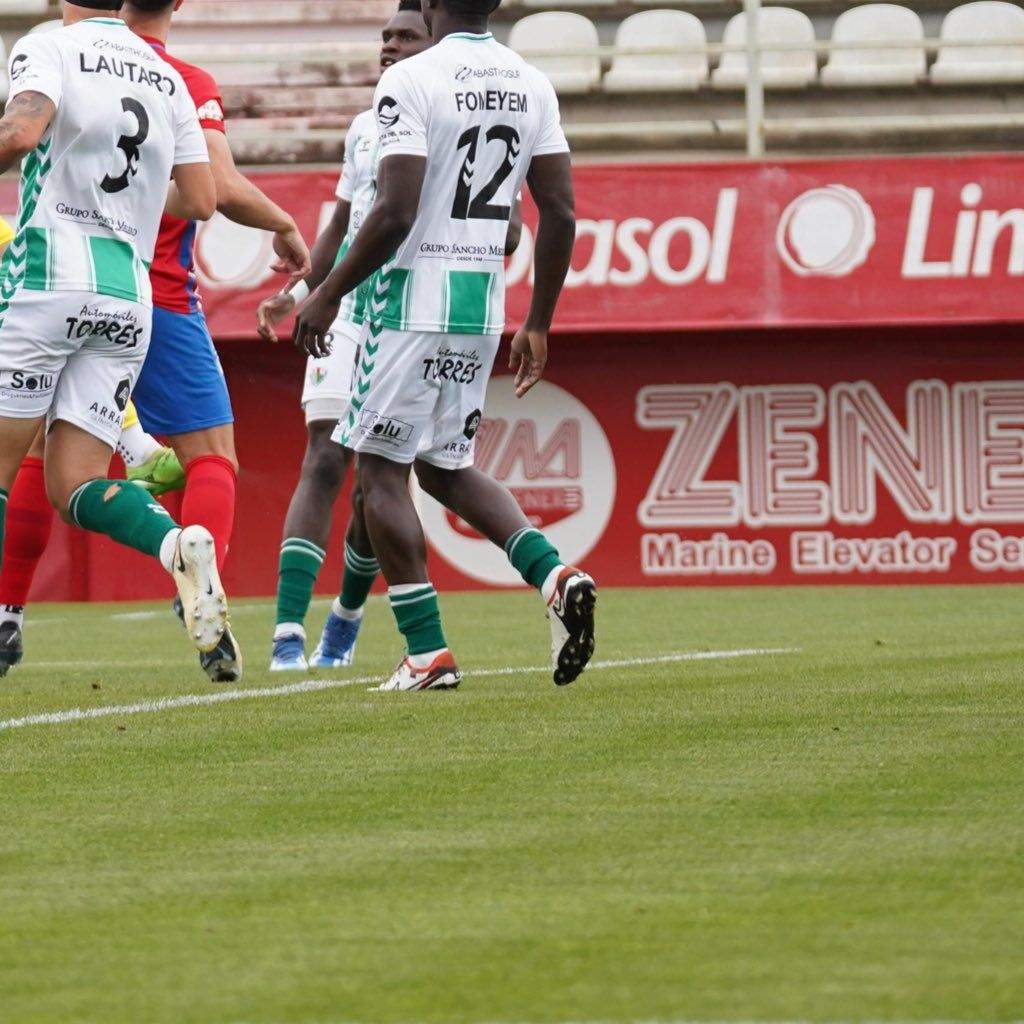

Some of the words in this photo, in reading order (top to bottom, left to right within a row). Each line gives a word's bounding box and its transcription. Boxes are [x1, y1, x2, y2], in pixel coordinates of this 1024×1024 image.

[100, 97, 150, 193] 3
[450, 124, 521, 220] 12
[901, 182, 1024, 278] Lin
[65, 316, 143, 348] TORRES
[643, 533, 774, 573] Marine
[791, 529, 955, 572] Elevator
